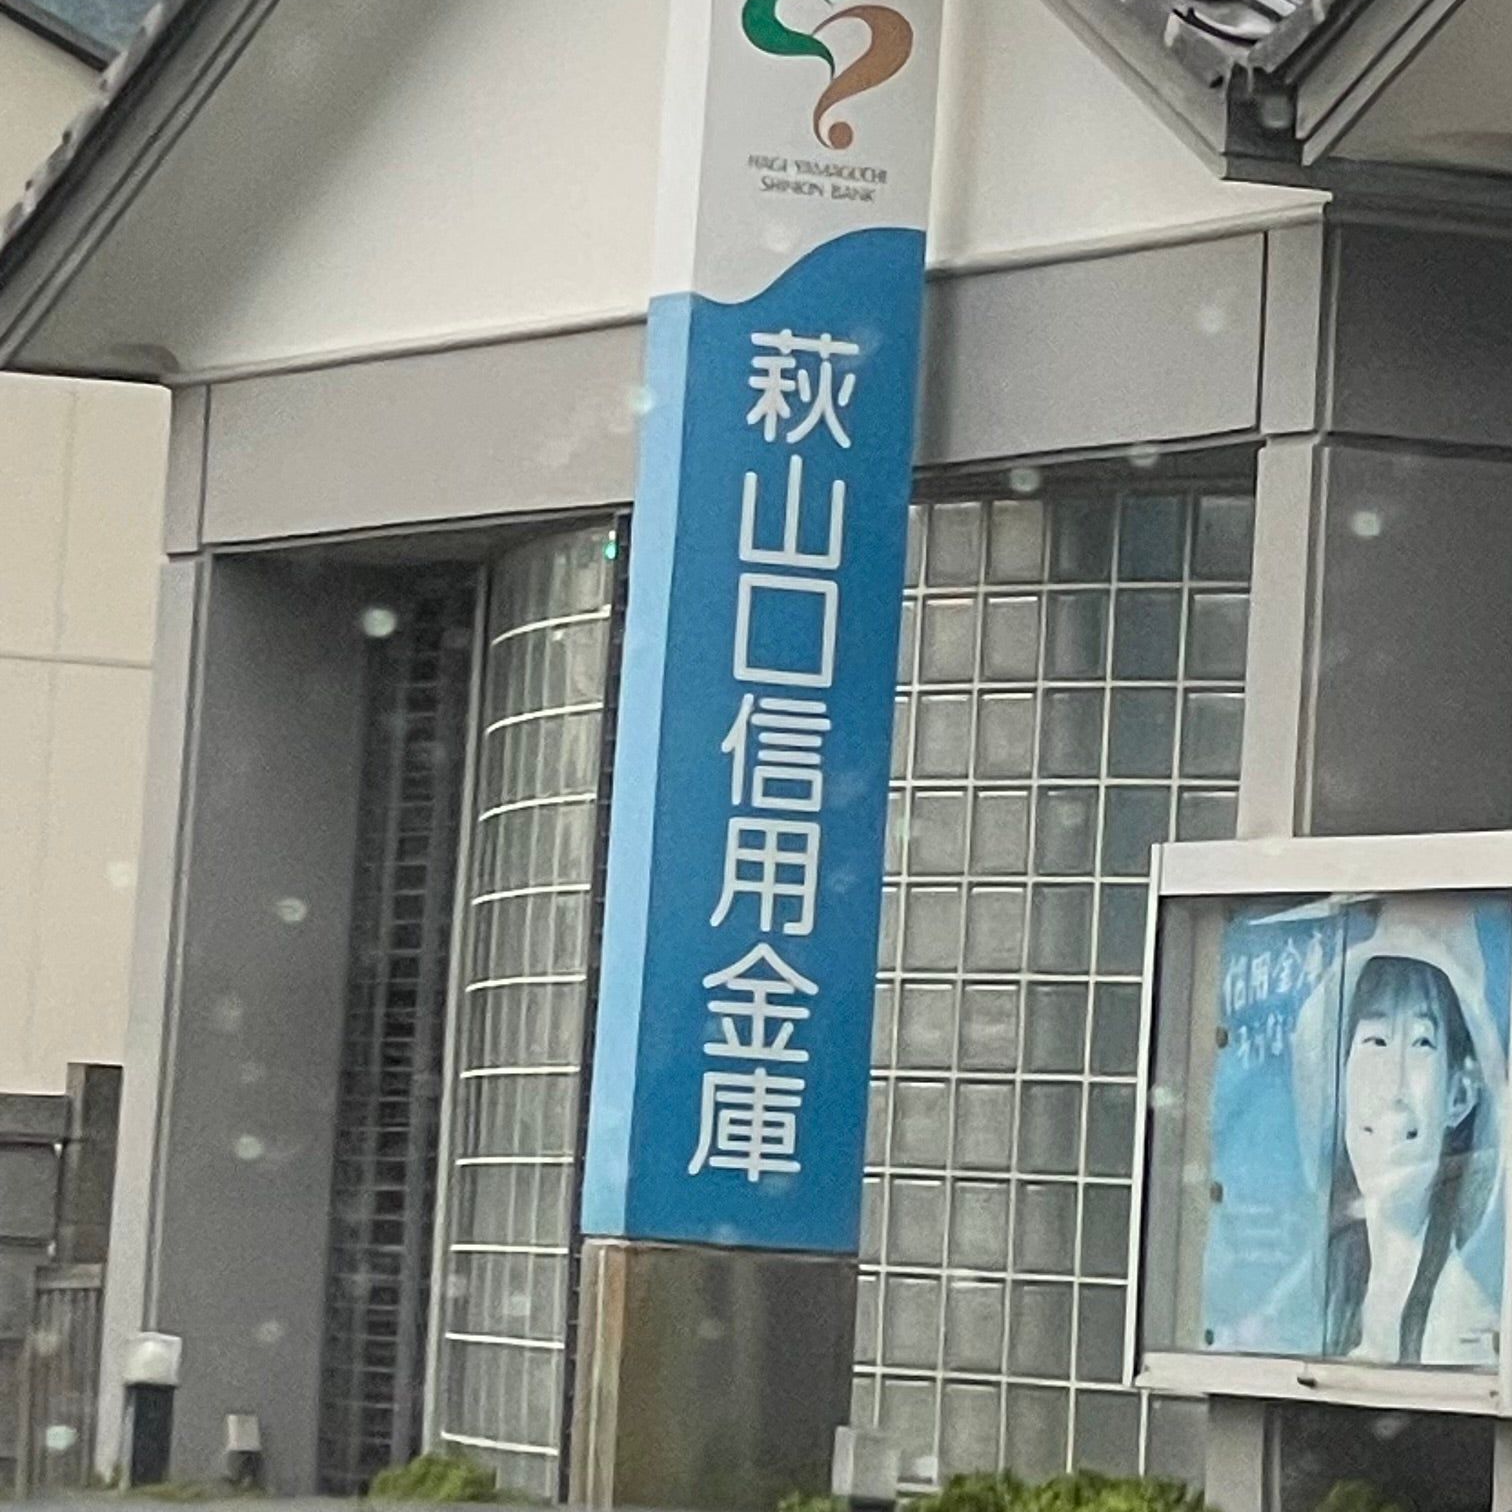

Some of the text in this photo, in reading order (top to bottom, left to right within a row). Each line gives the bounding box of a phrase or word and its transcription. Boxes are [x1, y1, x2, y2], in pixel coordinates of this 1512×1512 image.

[748, 154, 887, 184] HAGI YAMAGUCHI
[760, 175, 876, 202] SHINKIN BANK
[687, 329, 859, 1183] 萩山口信用金庫
